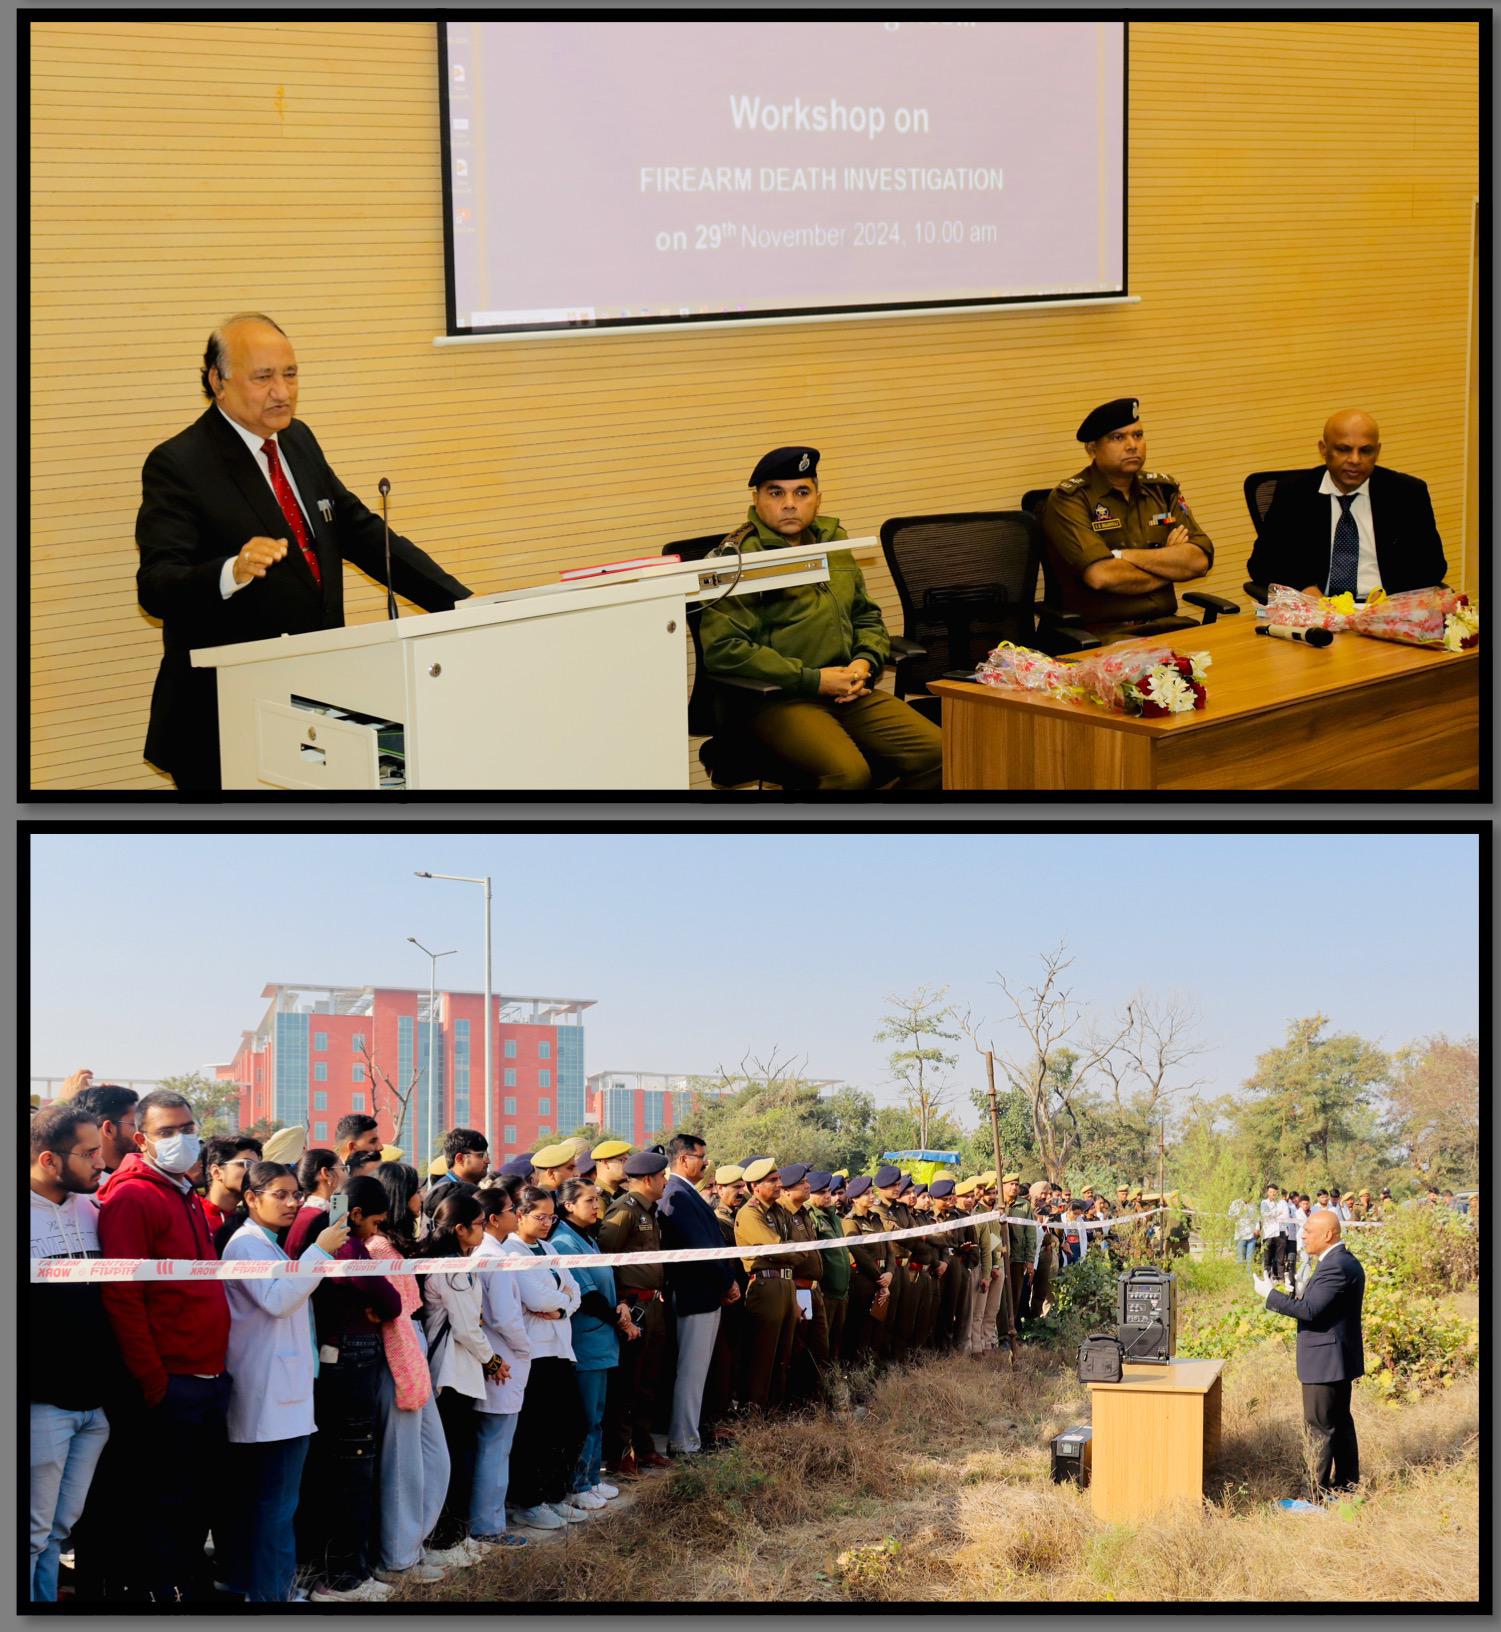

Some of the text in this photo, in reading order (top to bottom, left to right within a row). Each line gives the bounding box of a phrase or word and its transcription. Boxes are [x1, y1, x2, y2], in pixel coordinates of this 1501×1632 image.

[730, 95, 929, 140] Workshop on
[640, 167, 1004, 192] FIREARM DEATH INVESTIGATION
[655, 221, 998, 250] on 29th November 2024, 10.00 am
